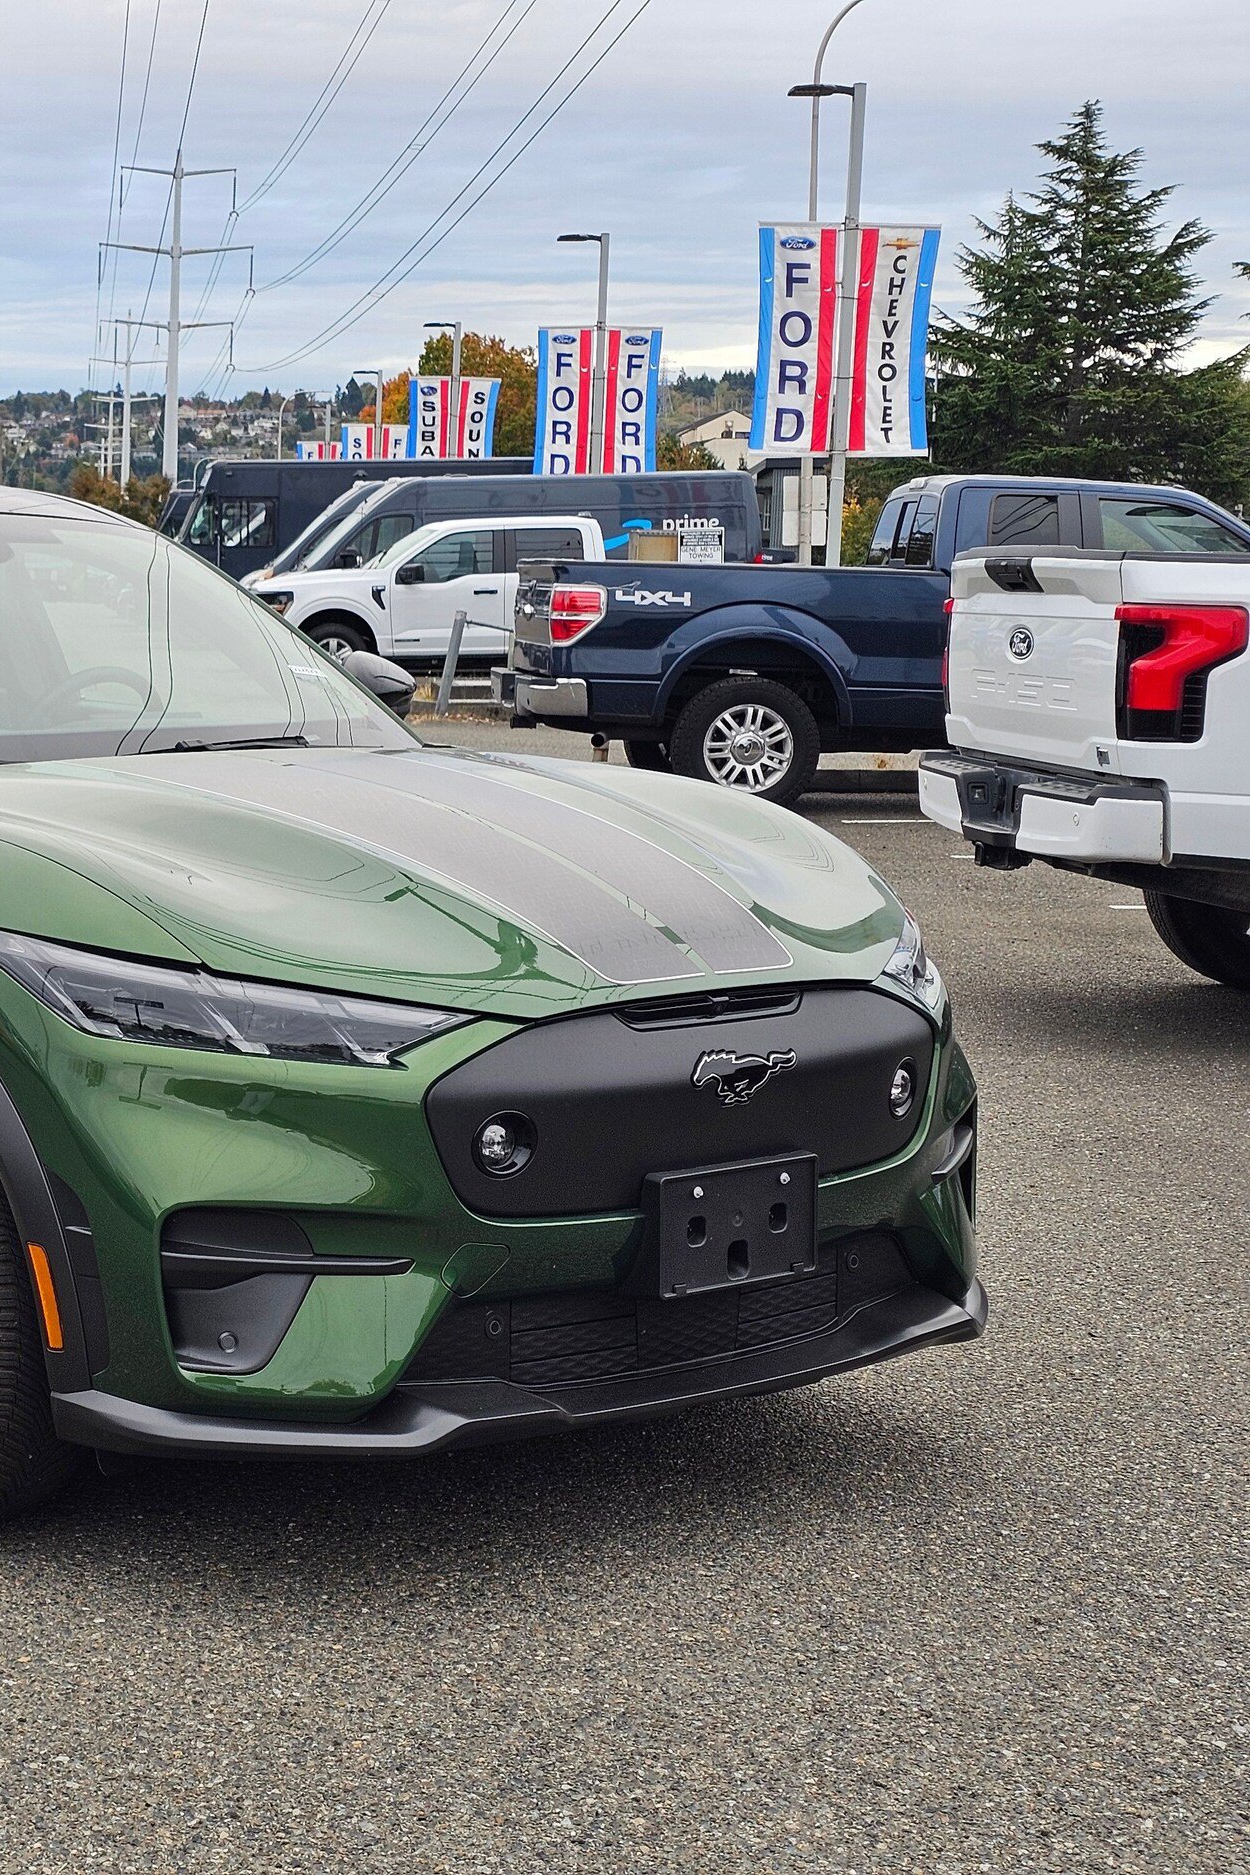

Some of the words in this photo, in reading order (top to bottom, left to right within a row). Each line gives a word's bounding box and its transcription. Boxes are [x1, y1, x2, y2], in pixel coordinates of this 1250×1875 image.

[773, 262, 813, 442] FORD
[877, 255, 908, 444] CHEVROLET
[550, 352, 574, 474] FORD
[621, 353, 646, 474] FORD
[662, 514, 720, 530] prime
